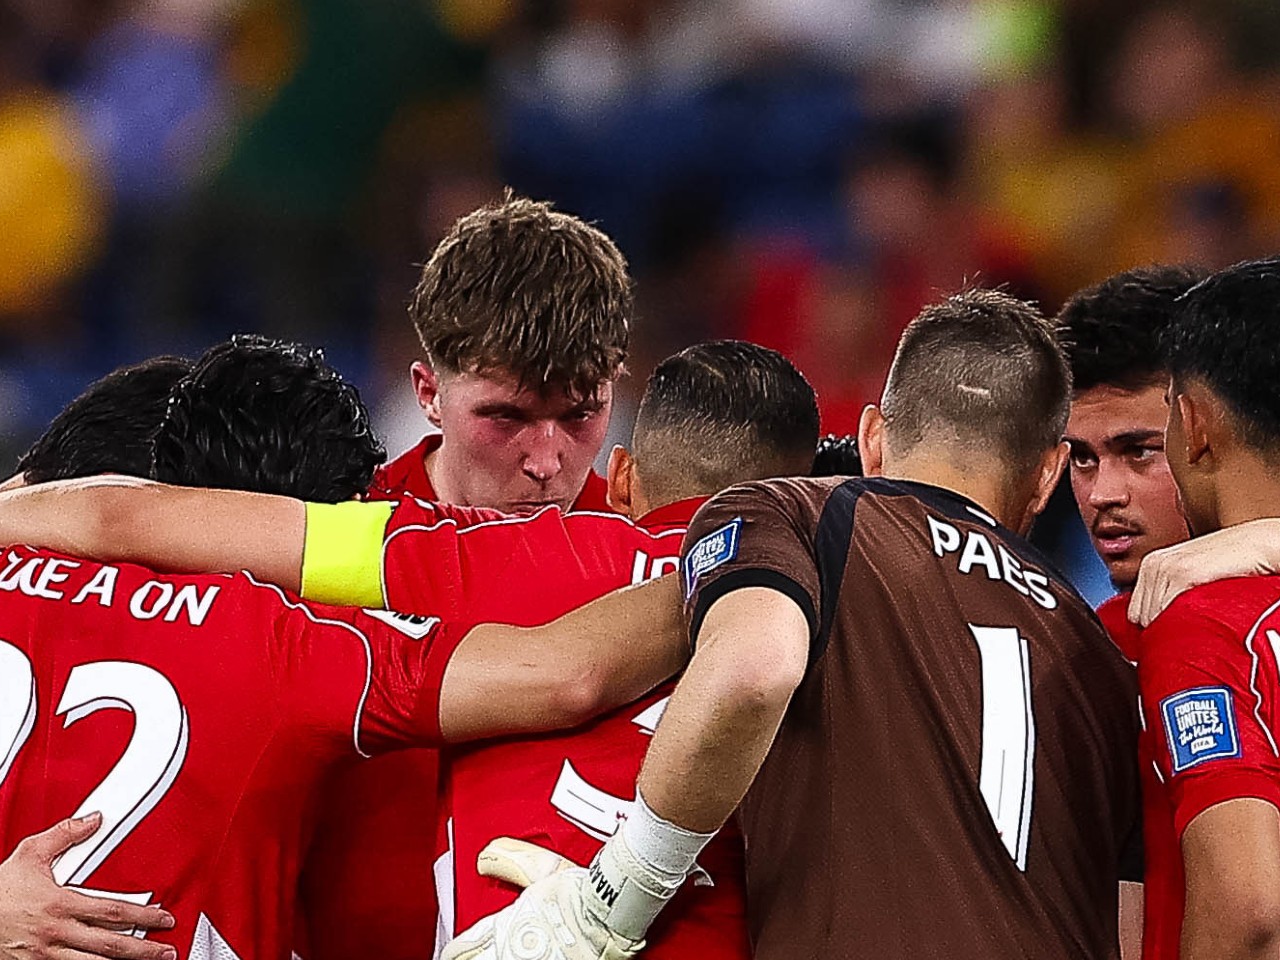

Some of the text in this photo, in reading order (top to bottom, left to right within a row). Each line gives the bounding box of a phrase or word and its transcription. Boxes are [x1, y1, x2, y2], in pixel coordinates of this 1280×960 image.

[926, 513, 1058, 610] PAES
[71, 565, 119, 607] A
[129, 580, 220, 627] ON
[1174, 700, 1217, 715] FOOTBALL
[1176, 711, 1219, 731] UNITES
[967, 622, 1037, 873] 1
